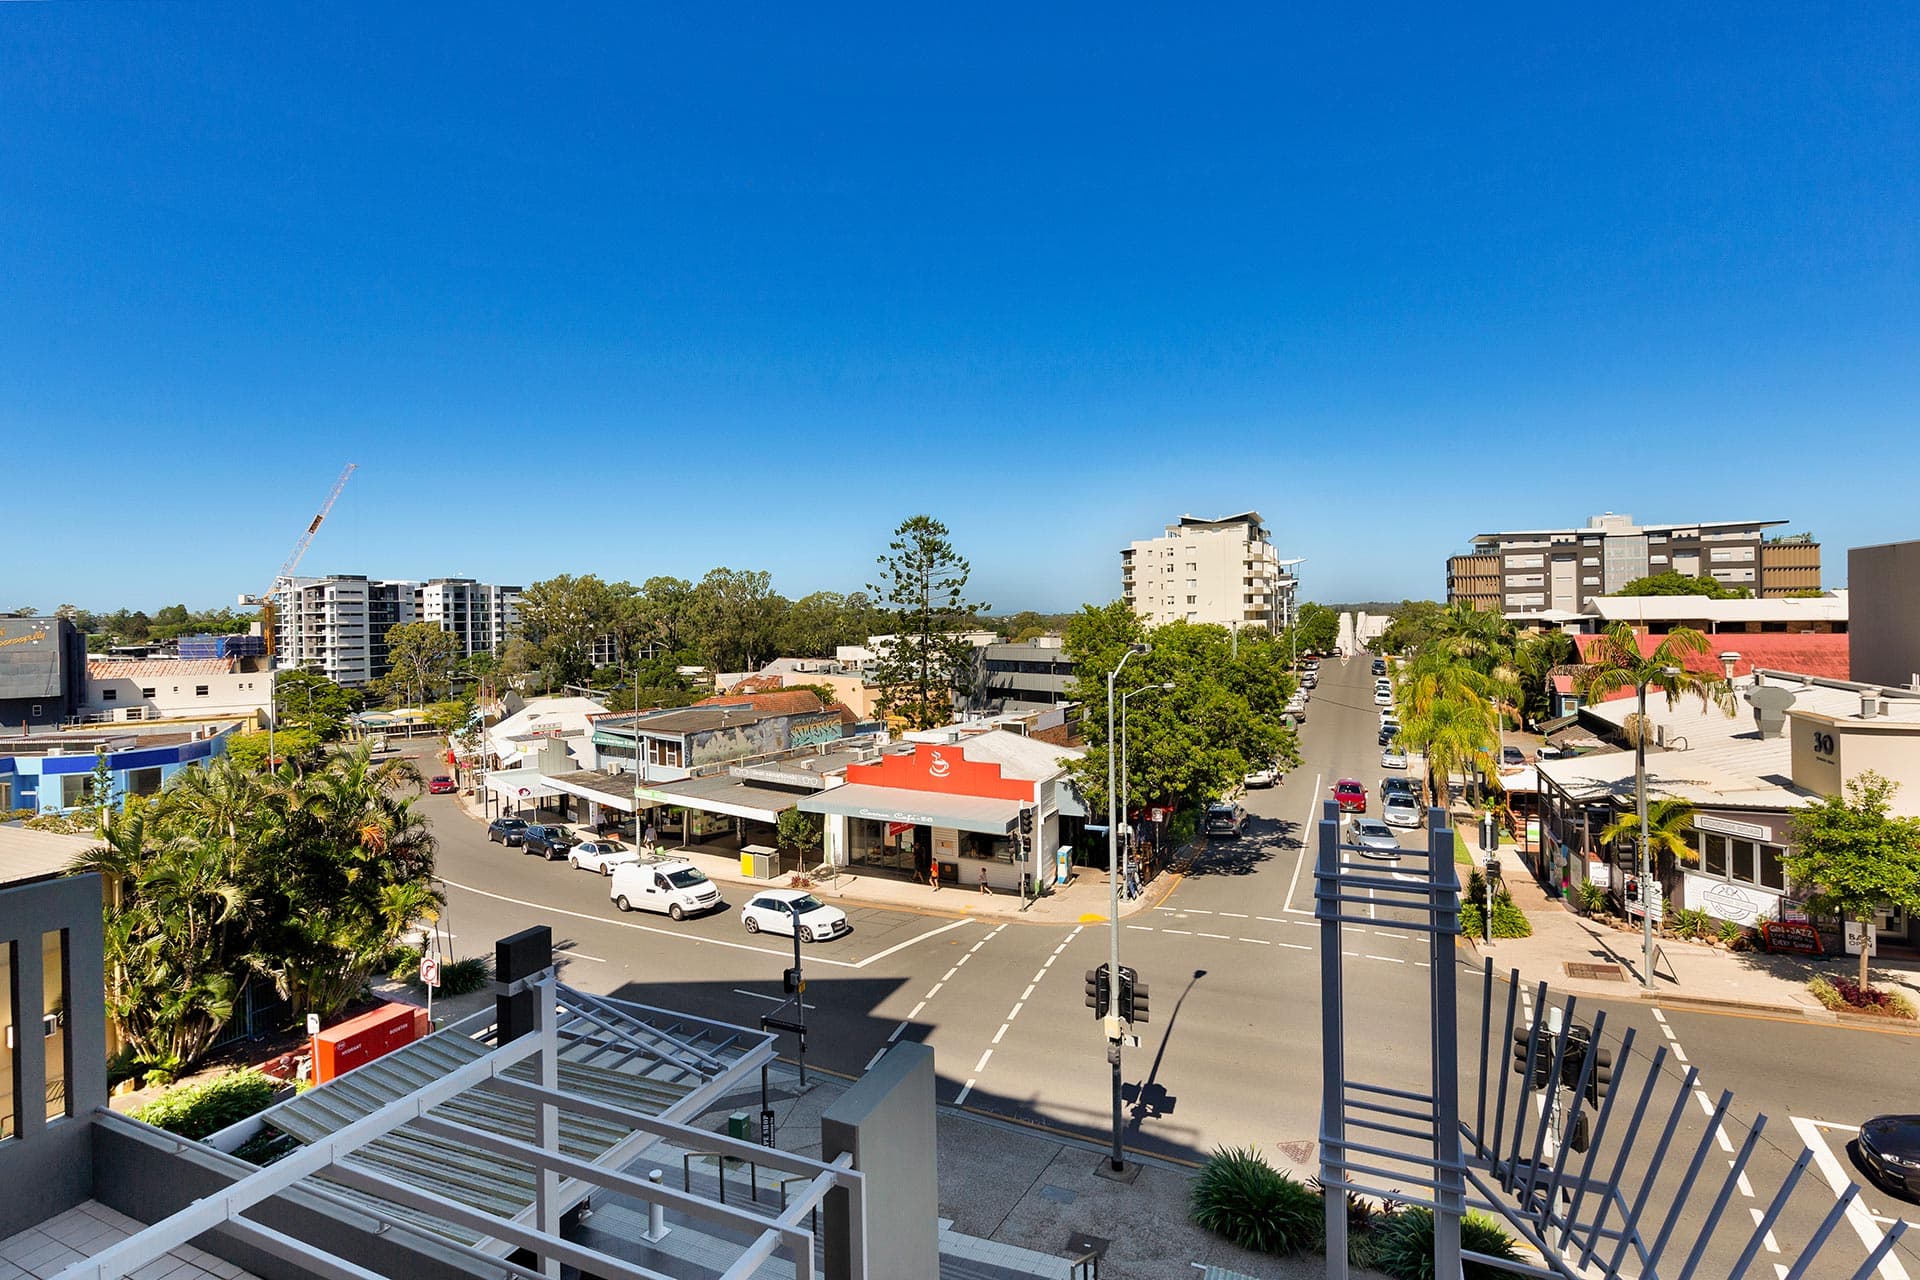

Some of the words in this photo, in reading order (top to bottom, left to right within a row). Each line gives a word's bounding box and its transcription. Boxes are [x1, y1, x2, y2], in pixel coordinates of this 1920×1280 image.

[1813, 731, 1834, 756] 30
[1790, 927, 1814, 938] JAZZ
[1849, 934, 1872, 943] BAR
[1849, 941, 1873, 949] OPN
[341, 1042, 362, 1056] HYDRANT
